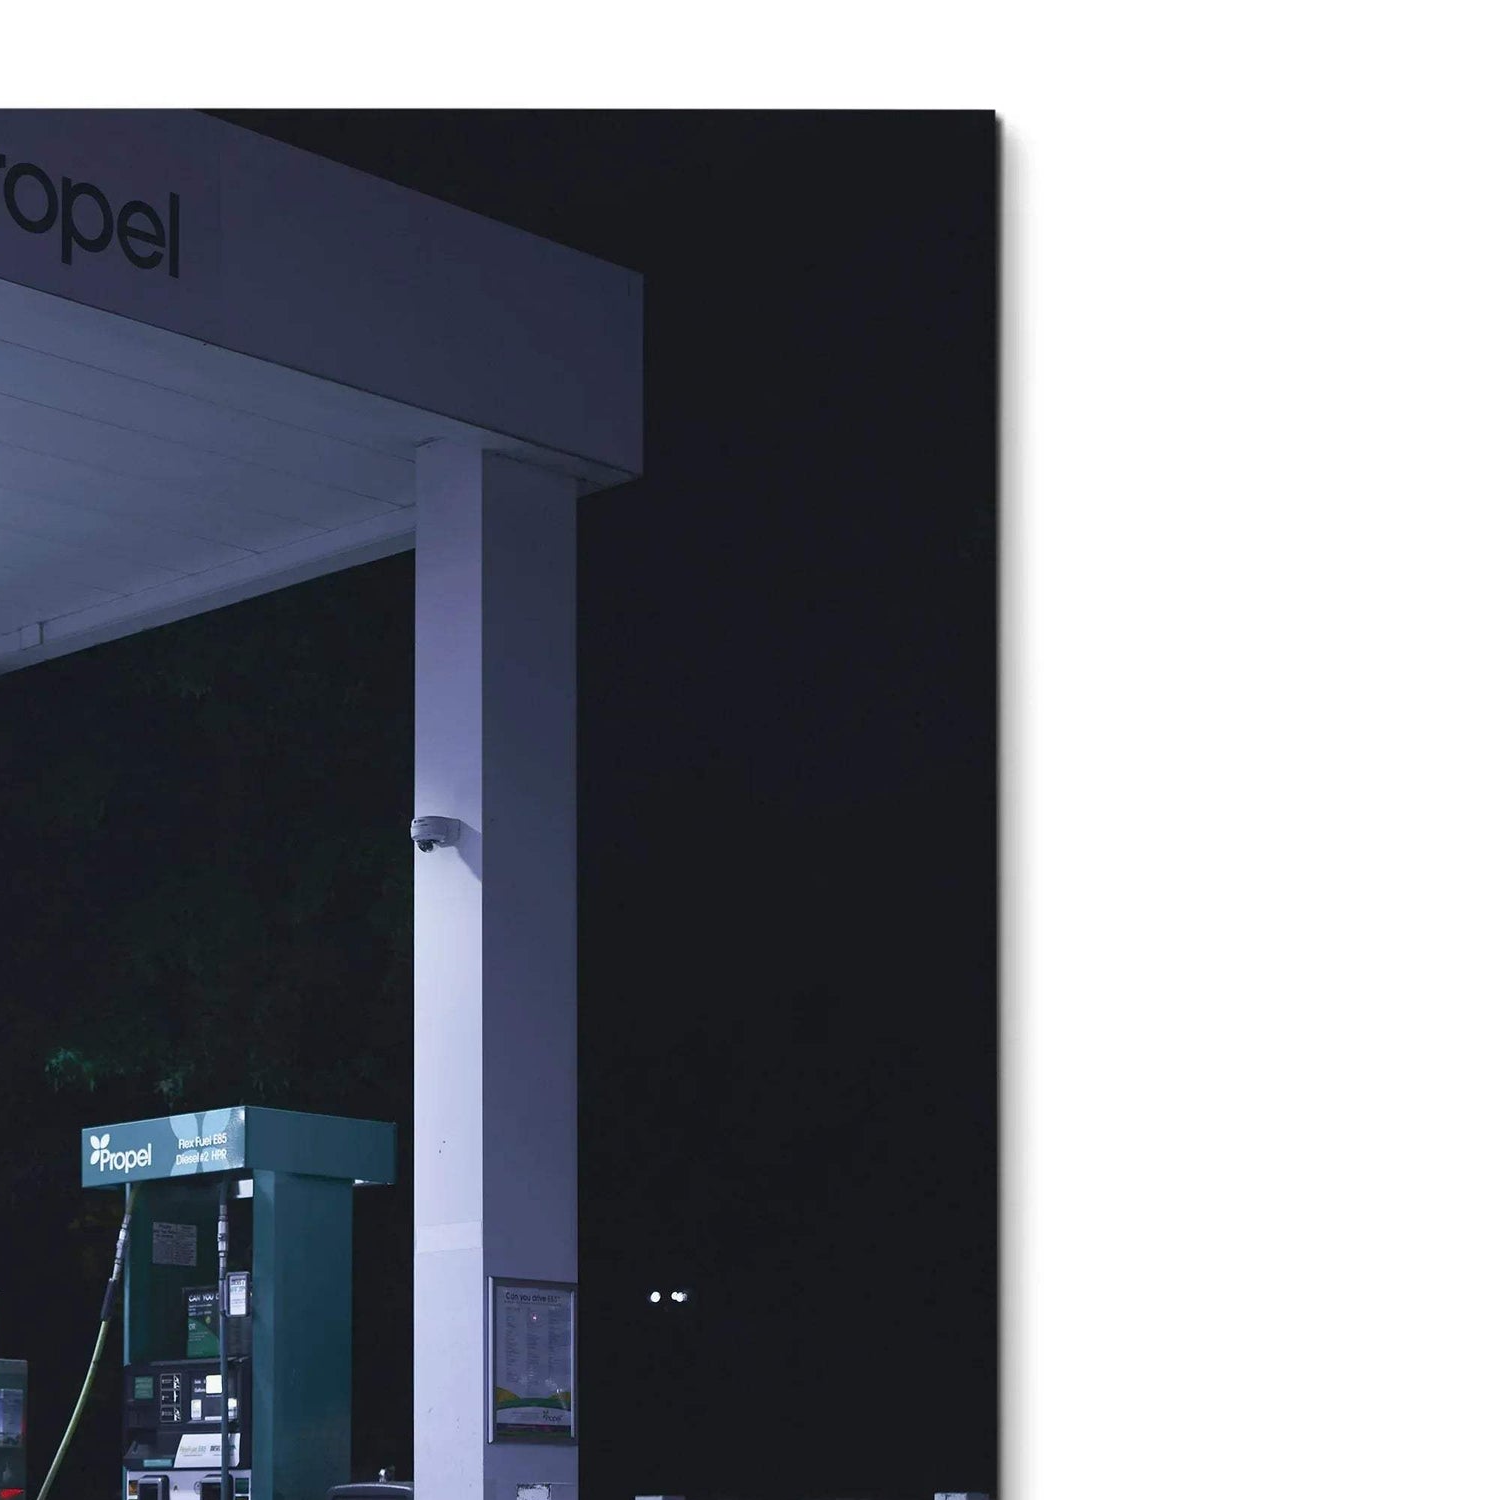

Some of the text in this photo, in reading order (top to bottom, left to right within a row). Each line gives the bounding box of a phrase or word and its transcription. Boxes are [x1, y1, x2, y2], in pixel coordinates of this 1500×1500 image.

[178, 1132, 227, 1150] Flex Fuel E85
[99, 1143, 152, 1173] Propel
[176, 1151, 200, 1166] Diesel
[188, 1294, 200, 1302] CAN
[202, 1293, 214, 1301] YOU
